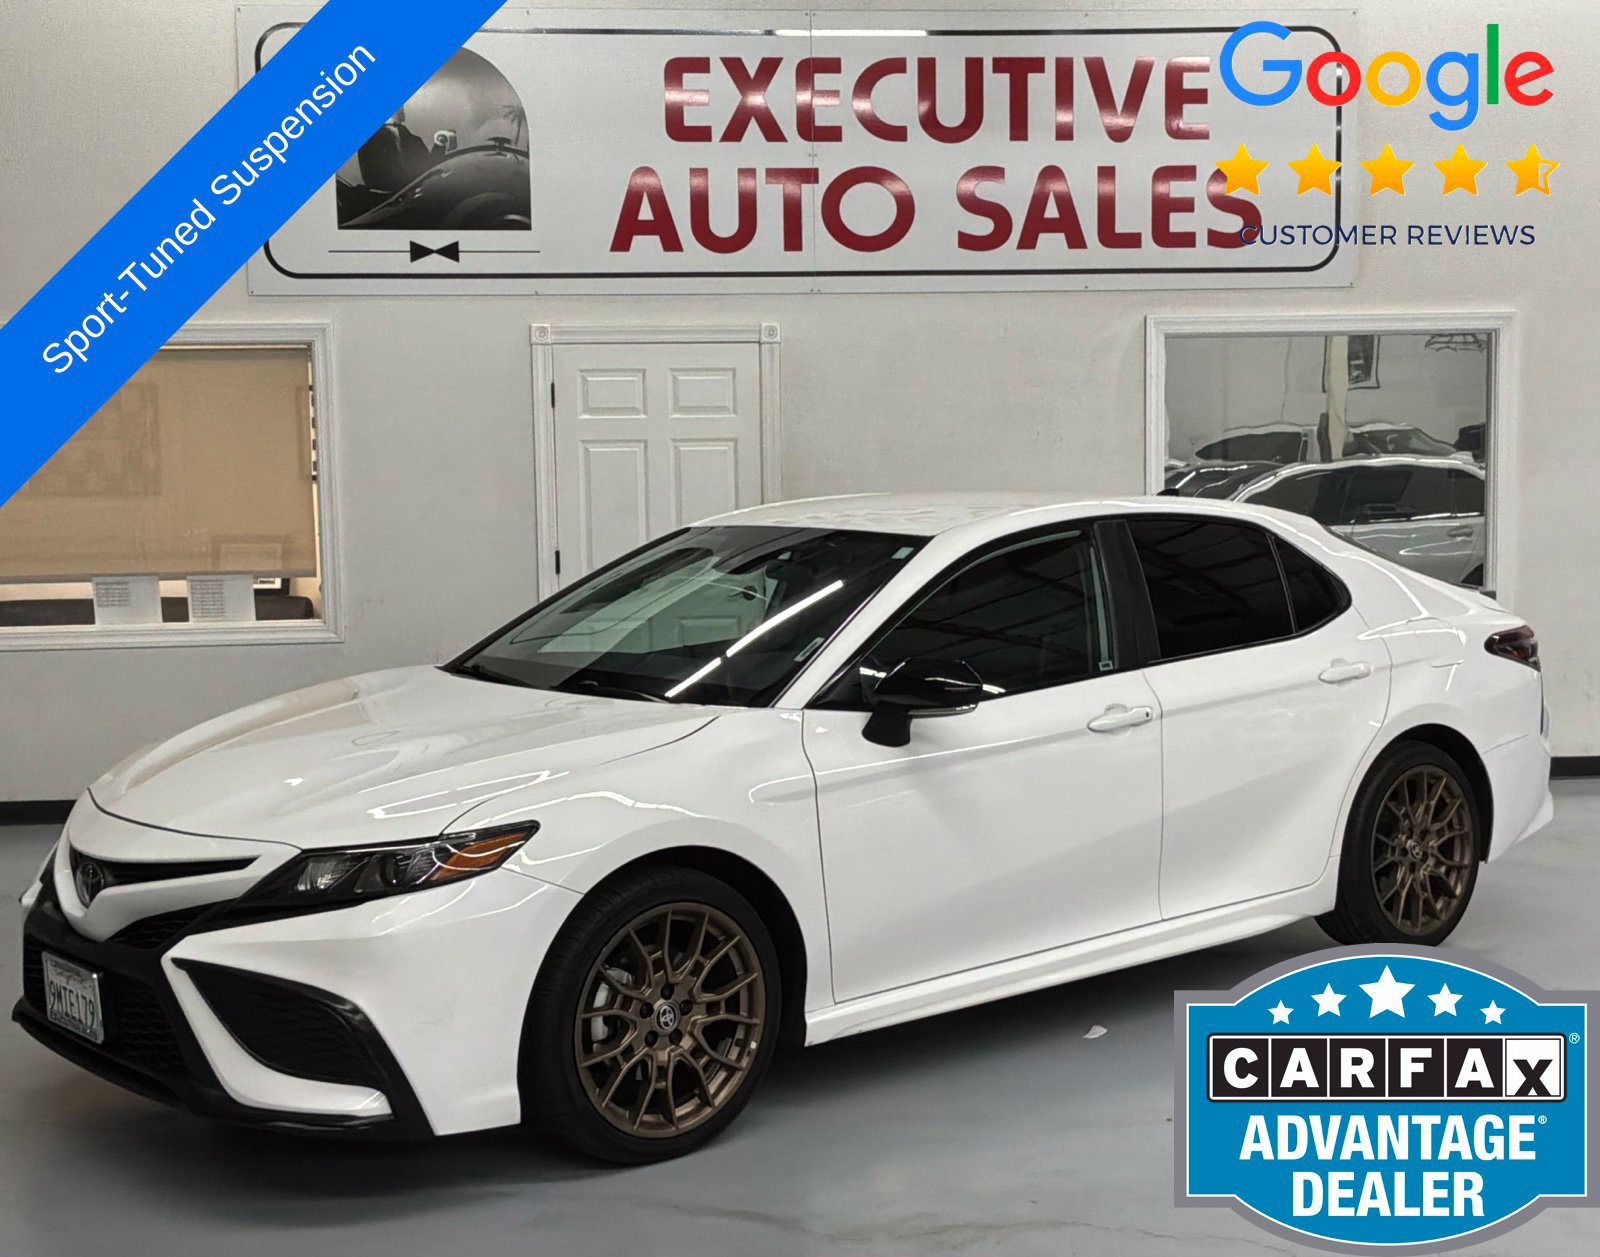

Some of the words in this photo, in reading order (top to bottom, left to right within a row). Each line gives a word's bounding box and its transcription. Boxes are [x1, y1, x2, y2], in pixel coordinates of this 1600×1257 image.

[663, 56, 1211, 144] EXECUTIVE
[609, 165, 916, 254] AUTO
[956, 163, 1263, 252] SALES
